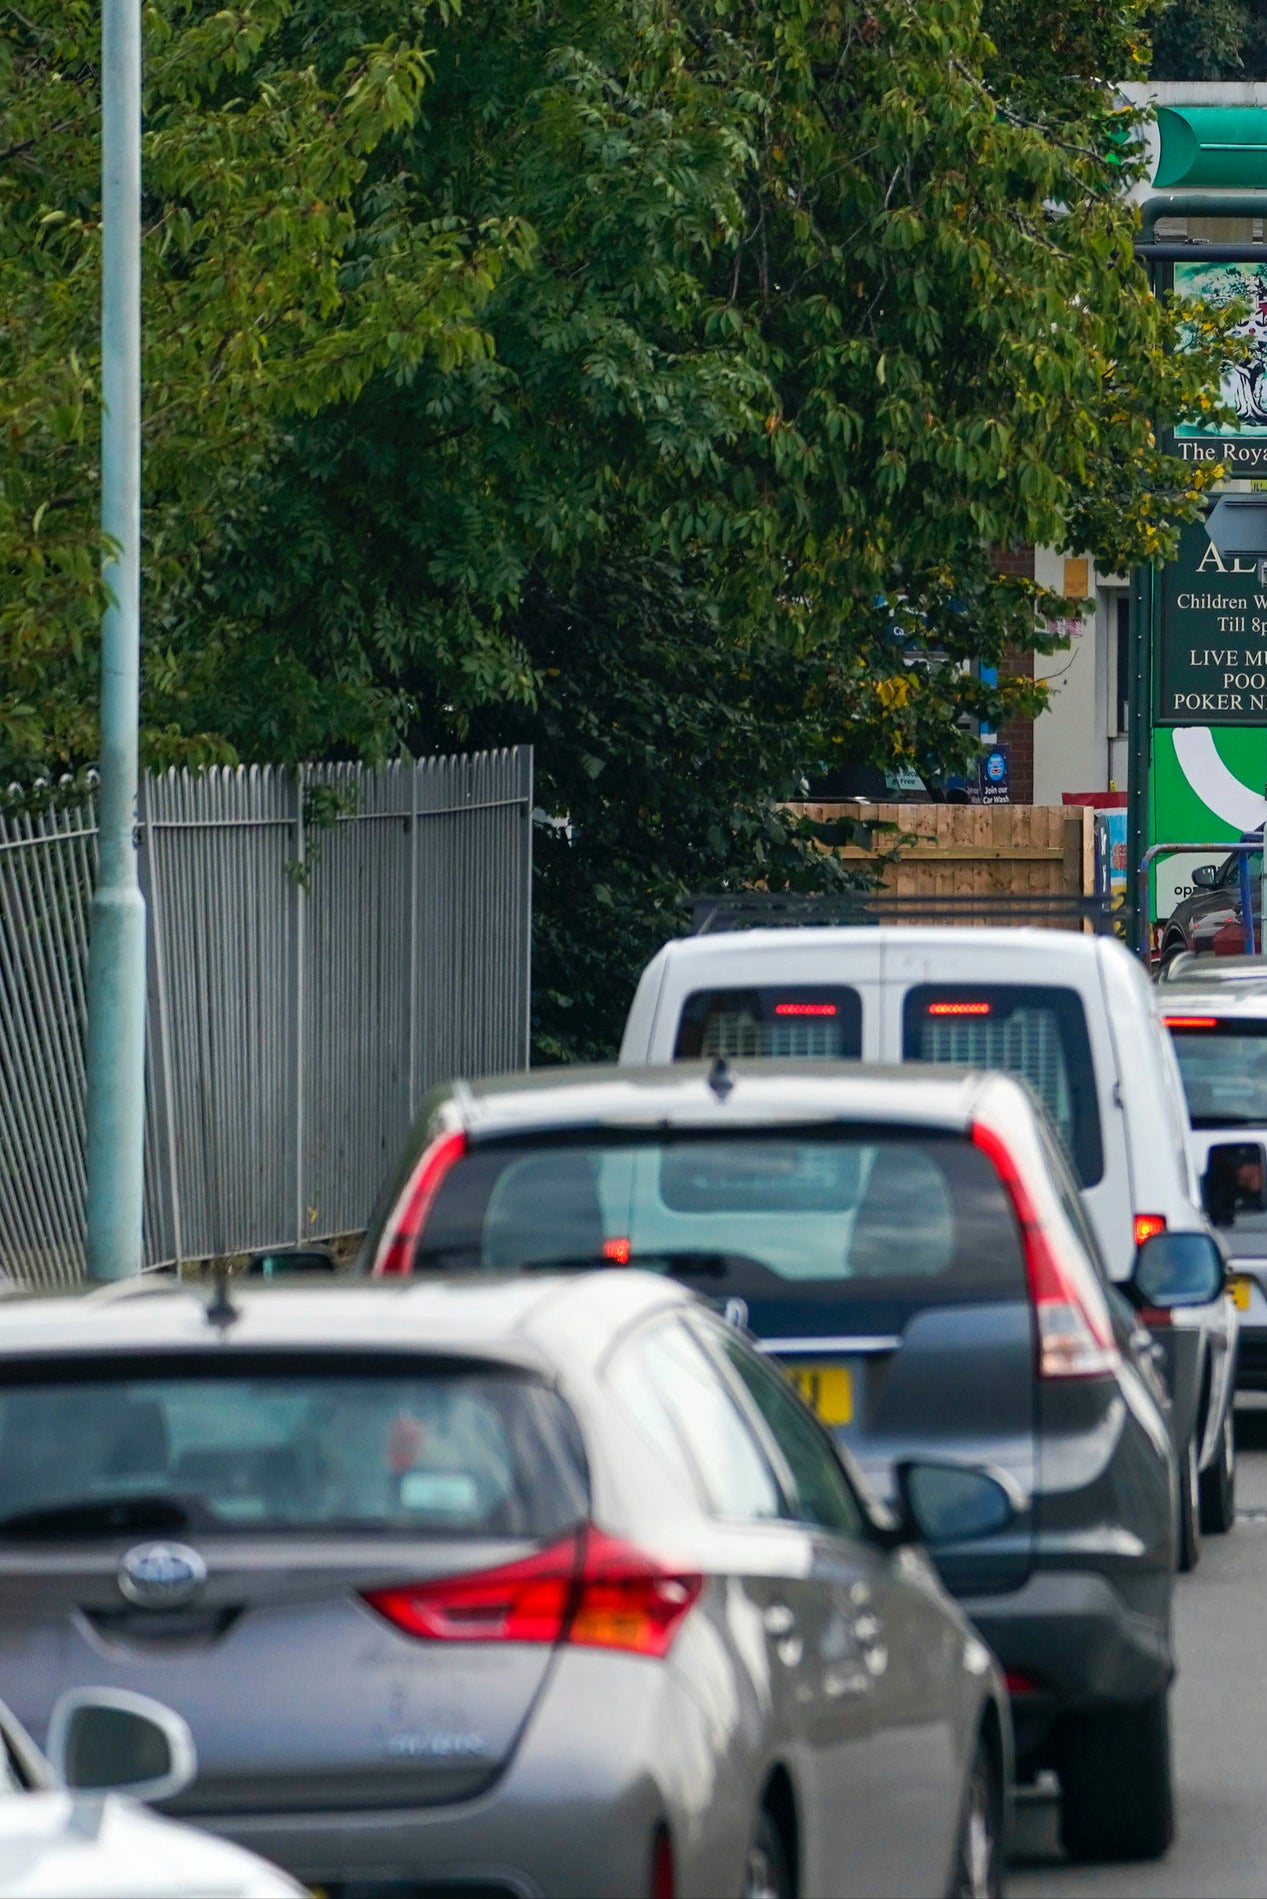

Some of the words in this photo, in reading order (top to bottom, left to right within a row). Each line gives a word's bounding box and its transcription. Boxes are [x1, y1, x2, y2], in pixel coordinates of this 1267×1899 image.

[1178, 442, 1216, 461] The
[1177, 593, 1248, 610] Children
[1217, 616, 1246, 632] Till
[1190, 650, 1239, 666] LIVE
[1174, 693, 1244, 711] POKER
[984, 785, 997, 795] Join
[982, 796, 993, 805] Car
[994, 795, 1010, 804] Wash
